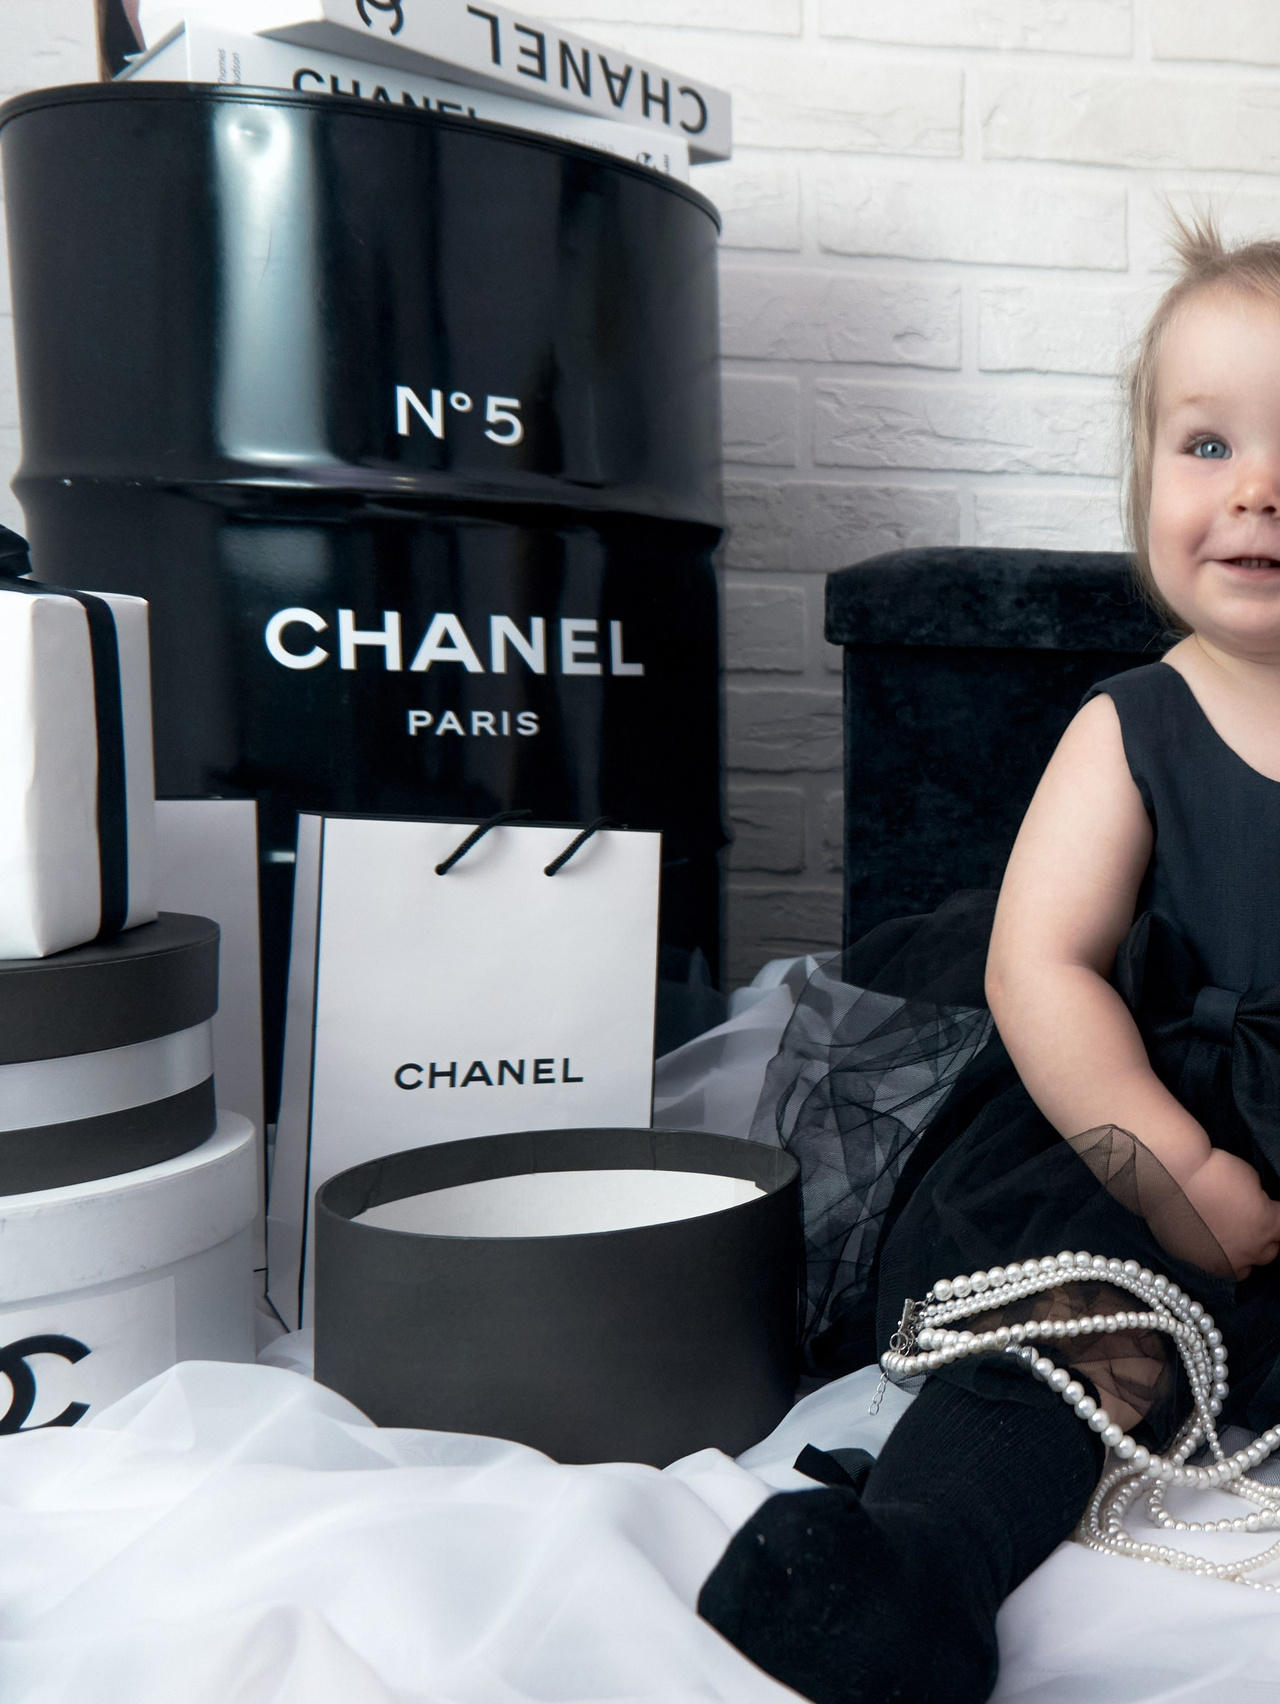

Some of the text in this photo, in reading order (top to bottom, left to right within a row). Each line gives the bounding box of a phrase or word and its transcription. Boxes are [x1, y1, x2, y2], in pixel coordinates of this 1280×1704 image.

[466, 4, 708, 134] CHANEL
[265, 607, 645, 677] CHANEL
[408, 709, 540, 736] PARIS
[394, 1057, 584, 1091] CHANEL
